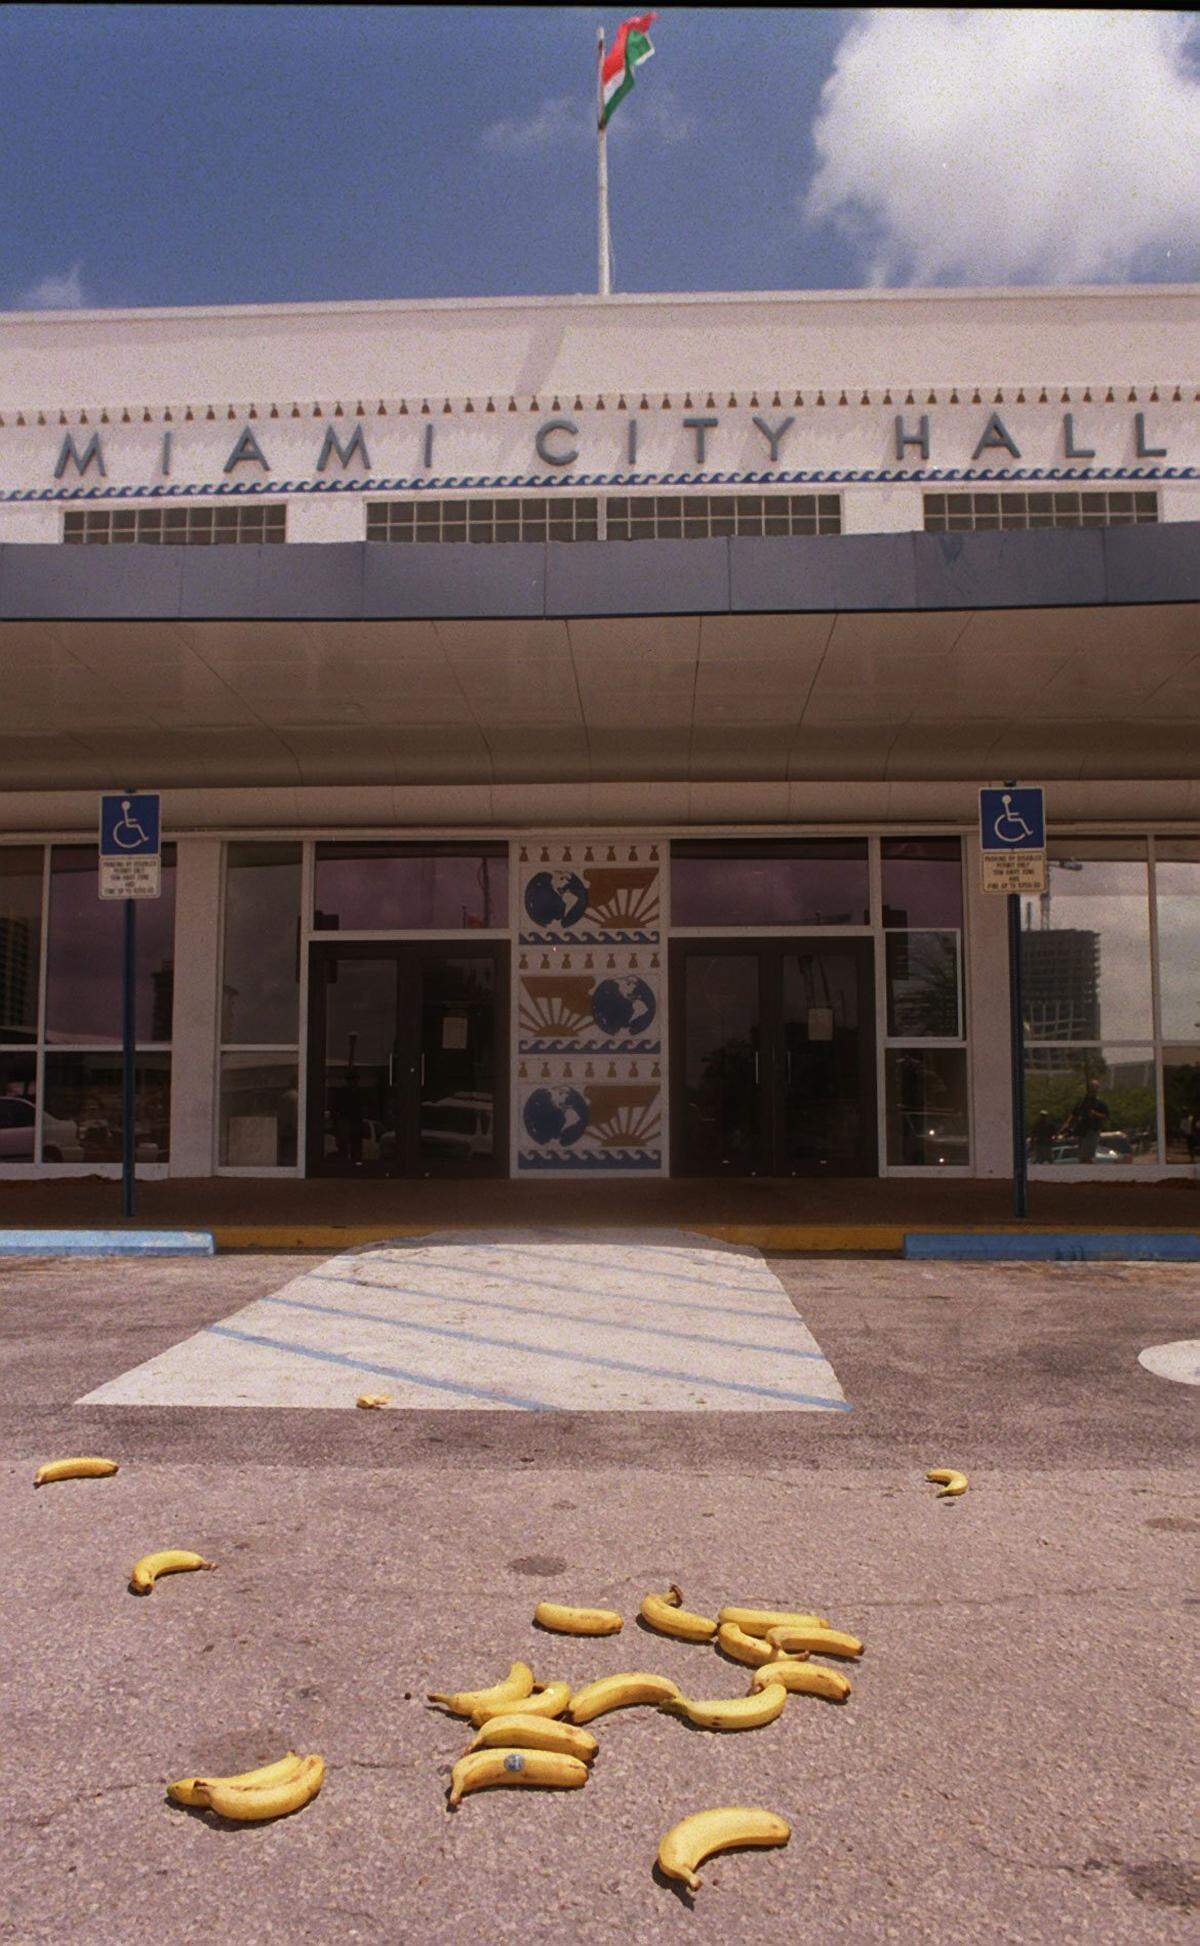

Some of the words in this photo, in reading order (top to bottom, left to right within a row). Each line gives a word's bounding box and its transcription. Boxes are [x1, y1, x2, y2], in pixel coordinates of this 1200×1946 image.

[53, 422, 434, 479] MIAMI
[535, 416, 796, 467] CITY
[893, 411, 1168, 460] HALL
